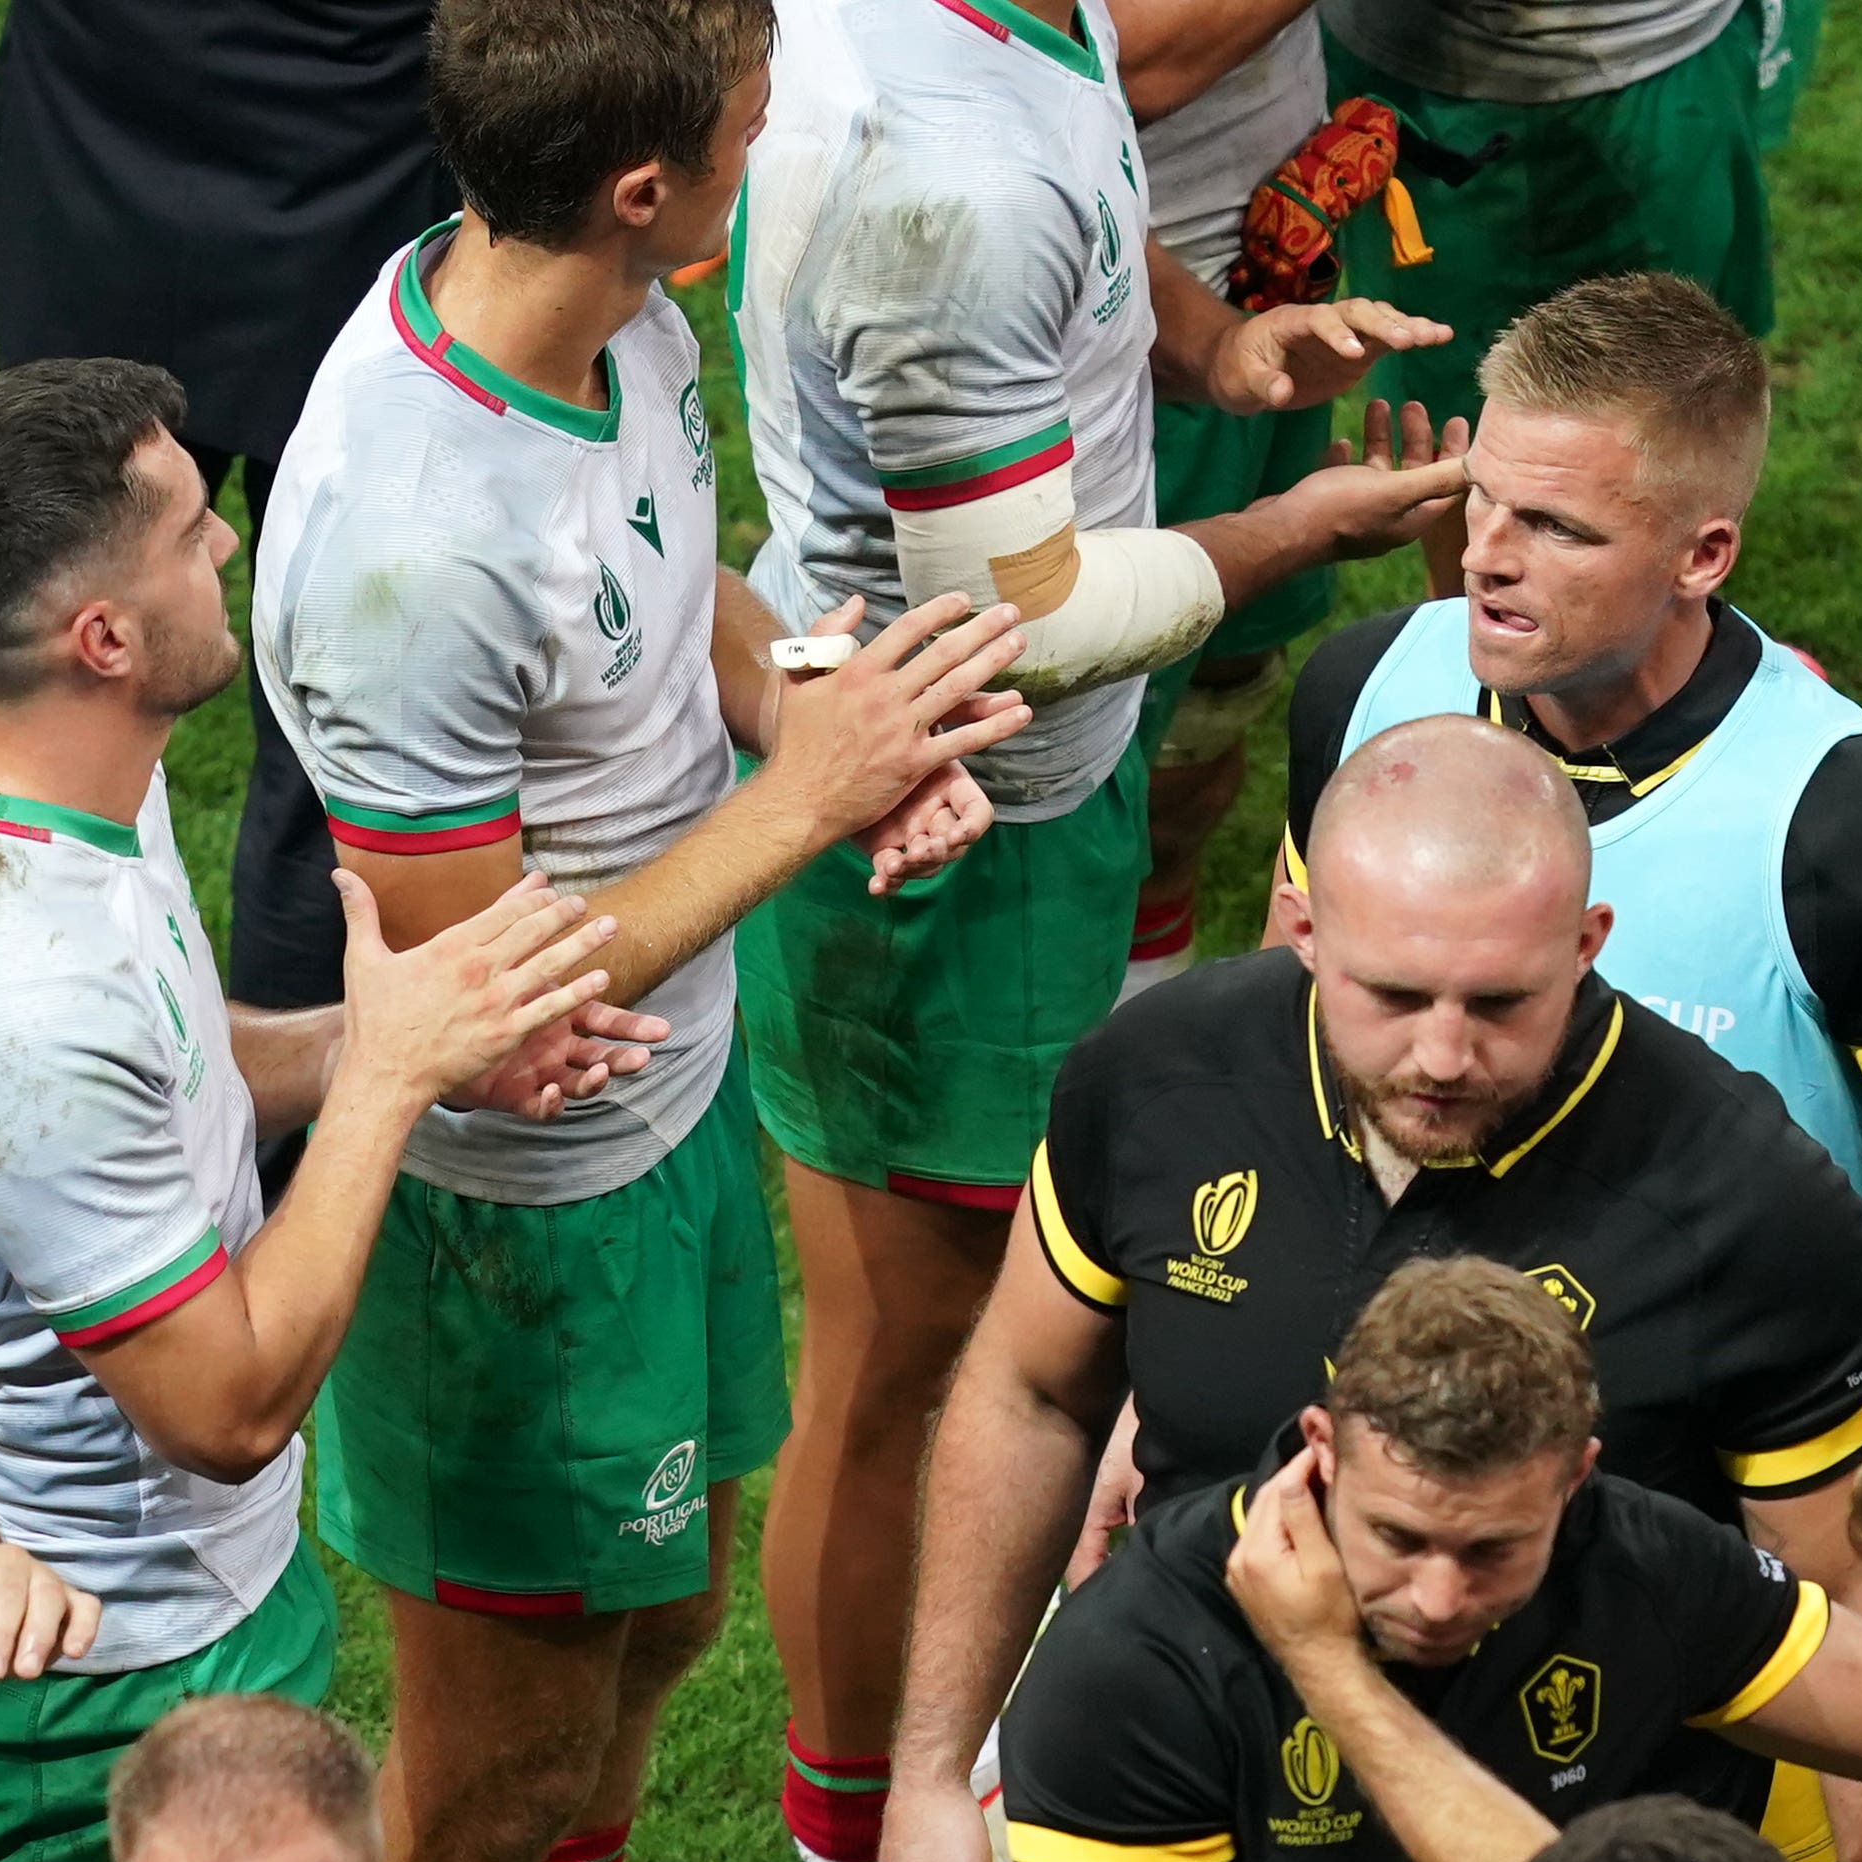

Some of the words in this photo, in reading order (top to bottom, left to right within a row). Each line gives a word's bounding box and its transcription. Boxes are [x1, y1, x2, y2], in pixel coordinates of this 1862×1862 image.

[600, 645, 634, 683] WORLD
[1166, 1275, 1206, 1295] FRANCE
[1204, 1285, 1233, 1303] 2023
[1167, 1259, 1217, 1285] WORLD
[1217, 1274, 1248, 1293] CUP
[618, 1494, 708, 1537] PORTUGAL
[644, 1516, 690, 1546] RUGBY
[1267, 1817, 1332, 1834] WORLD
[1332, 1811, 1364, 1832] CUP
